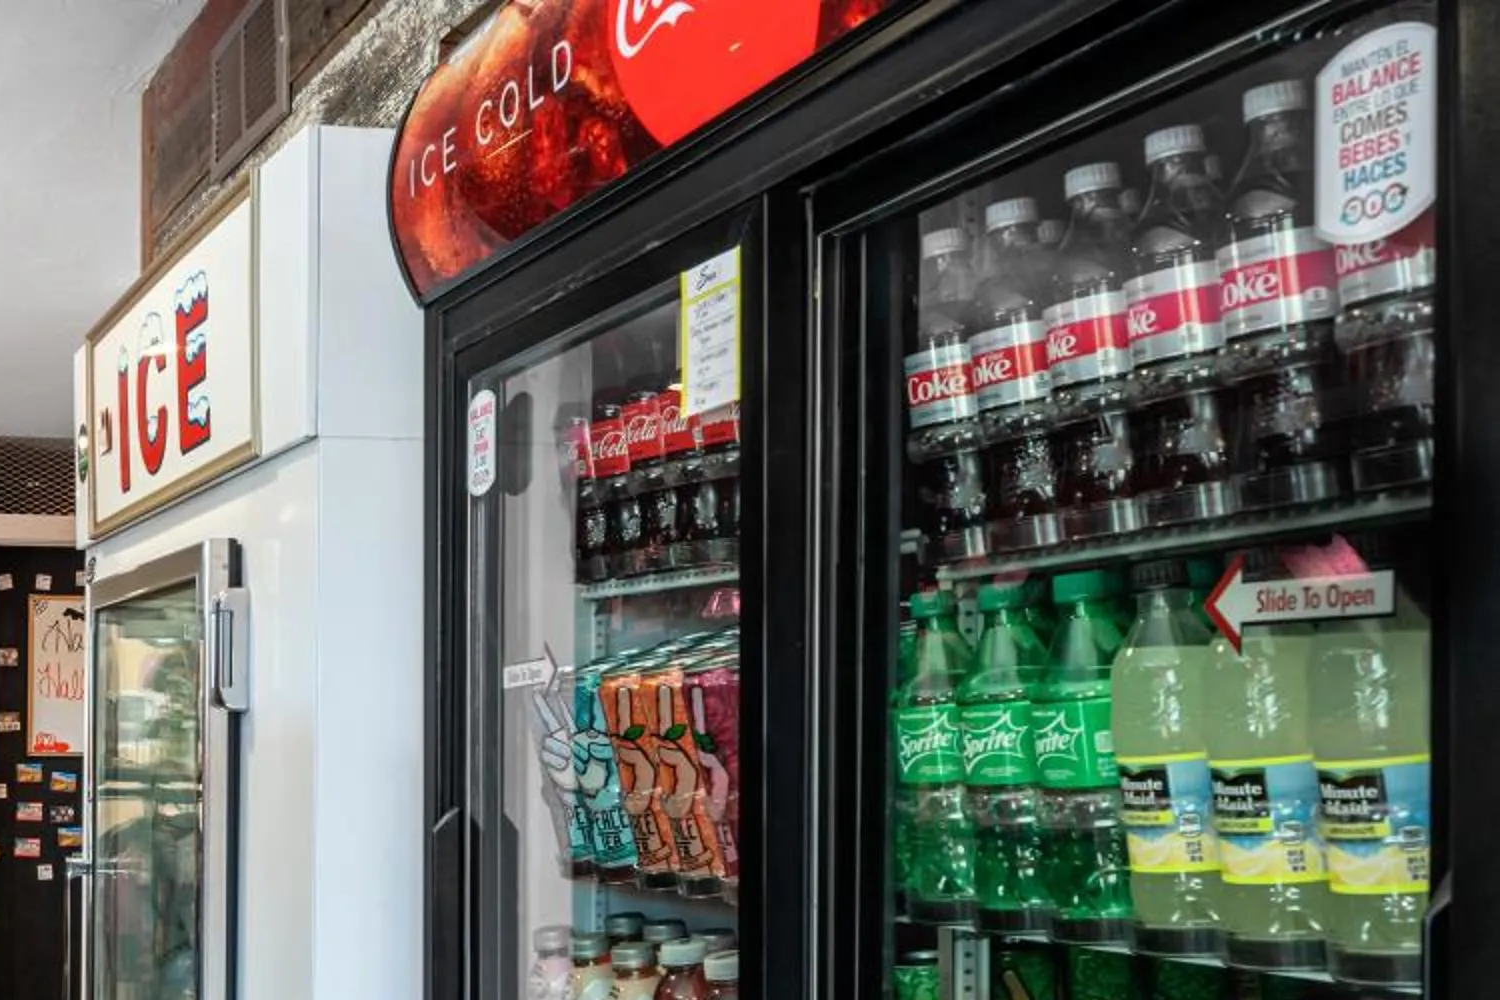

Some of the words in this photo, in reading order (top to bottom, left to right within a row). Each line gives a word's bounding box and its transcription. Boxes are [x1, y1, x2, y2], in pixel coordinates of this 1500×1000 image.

[1331, 52, 1421, 106] BALANCE
[409, 127, 457, 198] ICE
[475, 39, 573, 146] COLD
[1341, 101, 1408, 144] COMES
[1339, 128, 1400, 170] BEBES
[1344, 152, 1407, 192] HACES
[1336, 241, 1385, 275] oke
[1220, 269, 1278, 310] oke
[117, 268, 211, 494] ICE
[907, 371, 966, 406] Coke
[973, 356, 1011, 388] oke
[1256, 587, 1297, 613] Slide
[1302, 586, 1321, 609] To
[1326, 583, 1375, 613] Open
[900, 729, 950, 758] Sprite
[963, 728, 1016, 759] Sprite
[1320, 783, 1378, 799] Minute
[1326, 800, 1370, 816] Maid
